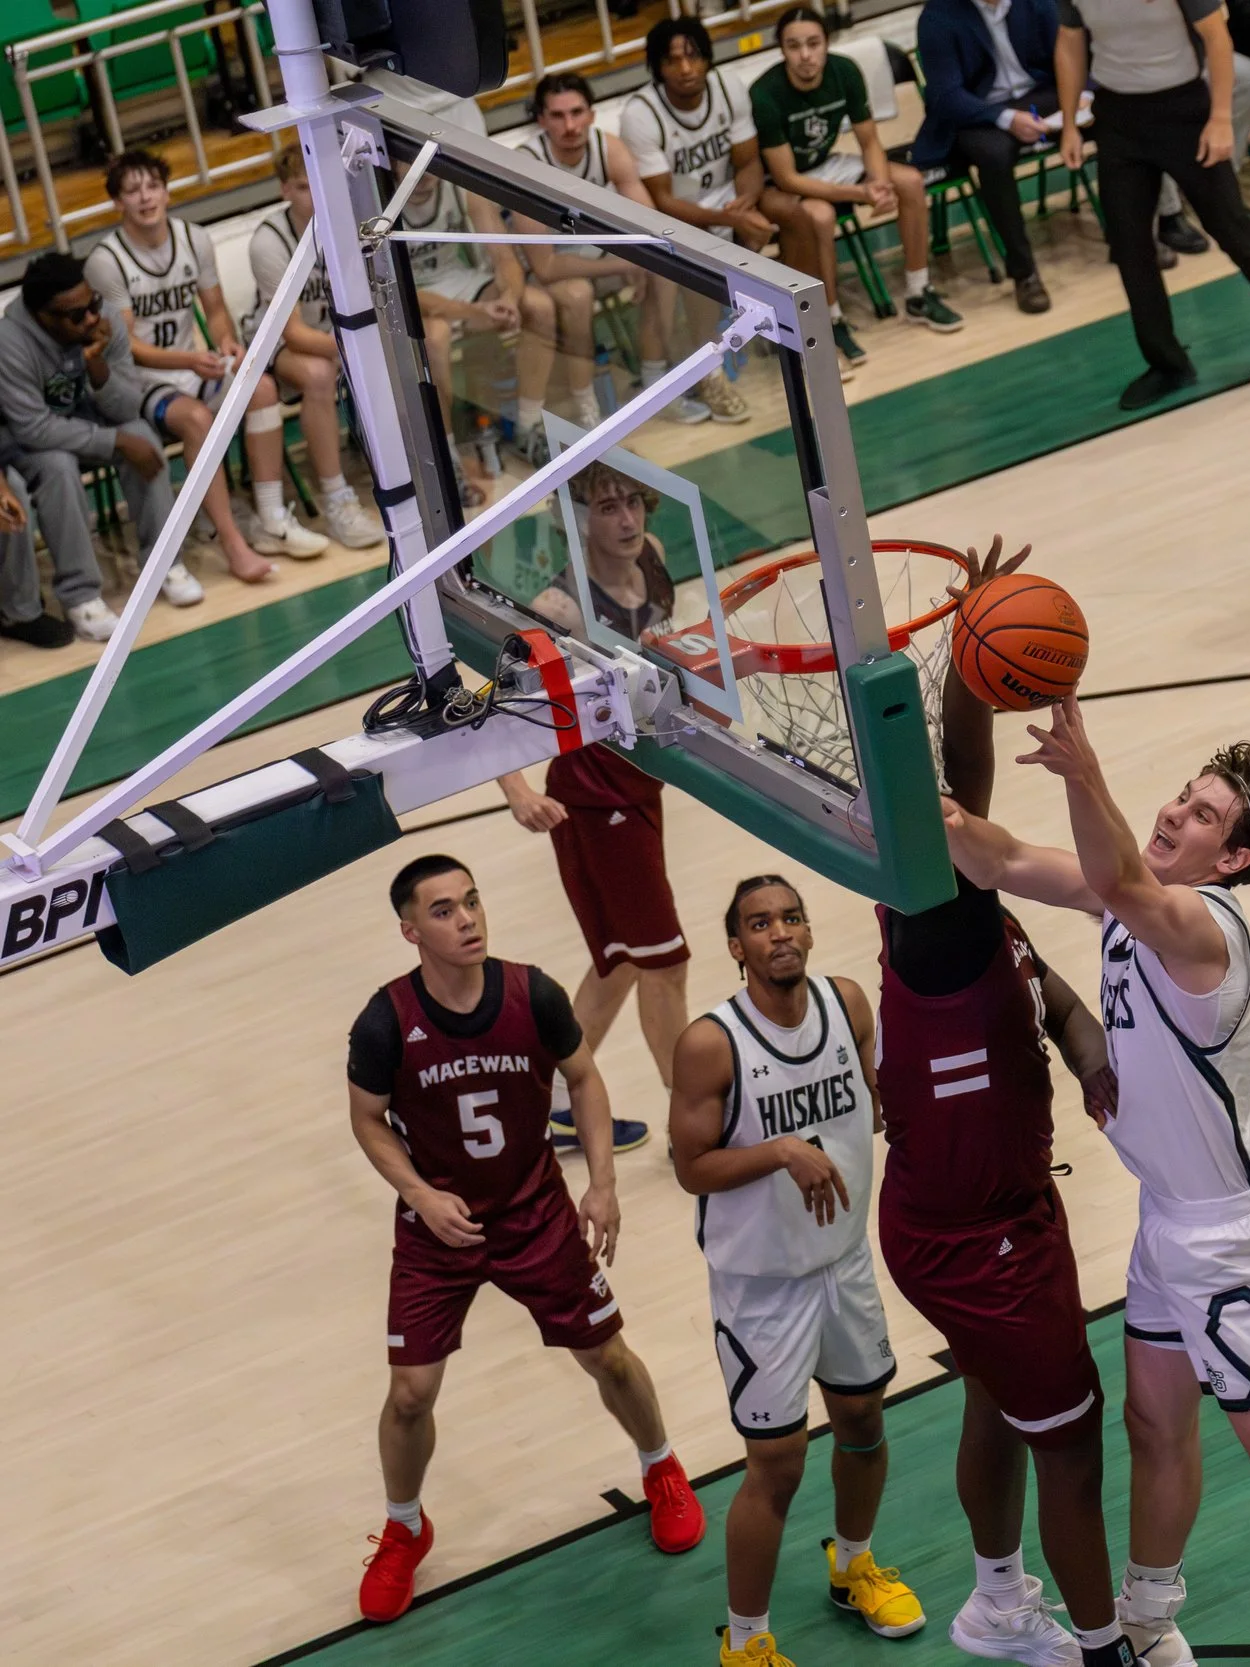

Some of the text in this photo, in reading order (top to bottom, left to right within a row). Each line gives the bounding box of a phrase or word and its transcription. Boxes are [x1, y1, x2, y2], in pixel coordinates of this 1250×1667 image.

[1, 869, 107, 959] BPI
[418, 1055, 530, 1088] MACEWAN
[756, 1070, 857, 1140] HUSKIES
[457, 1089, 506, 1159] 5
